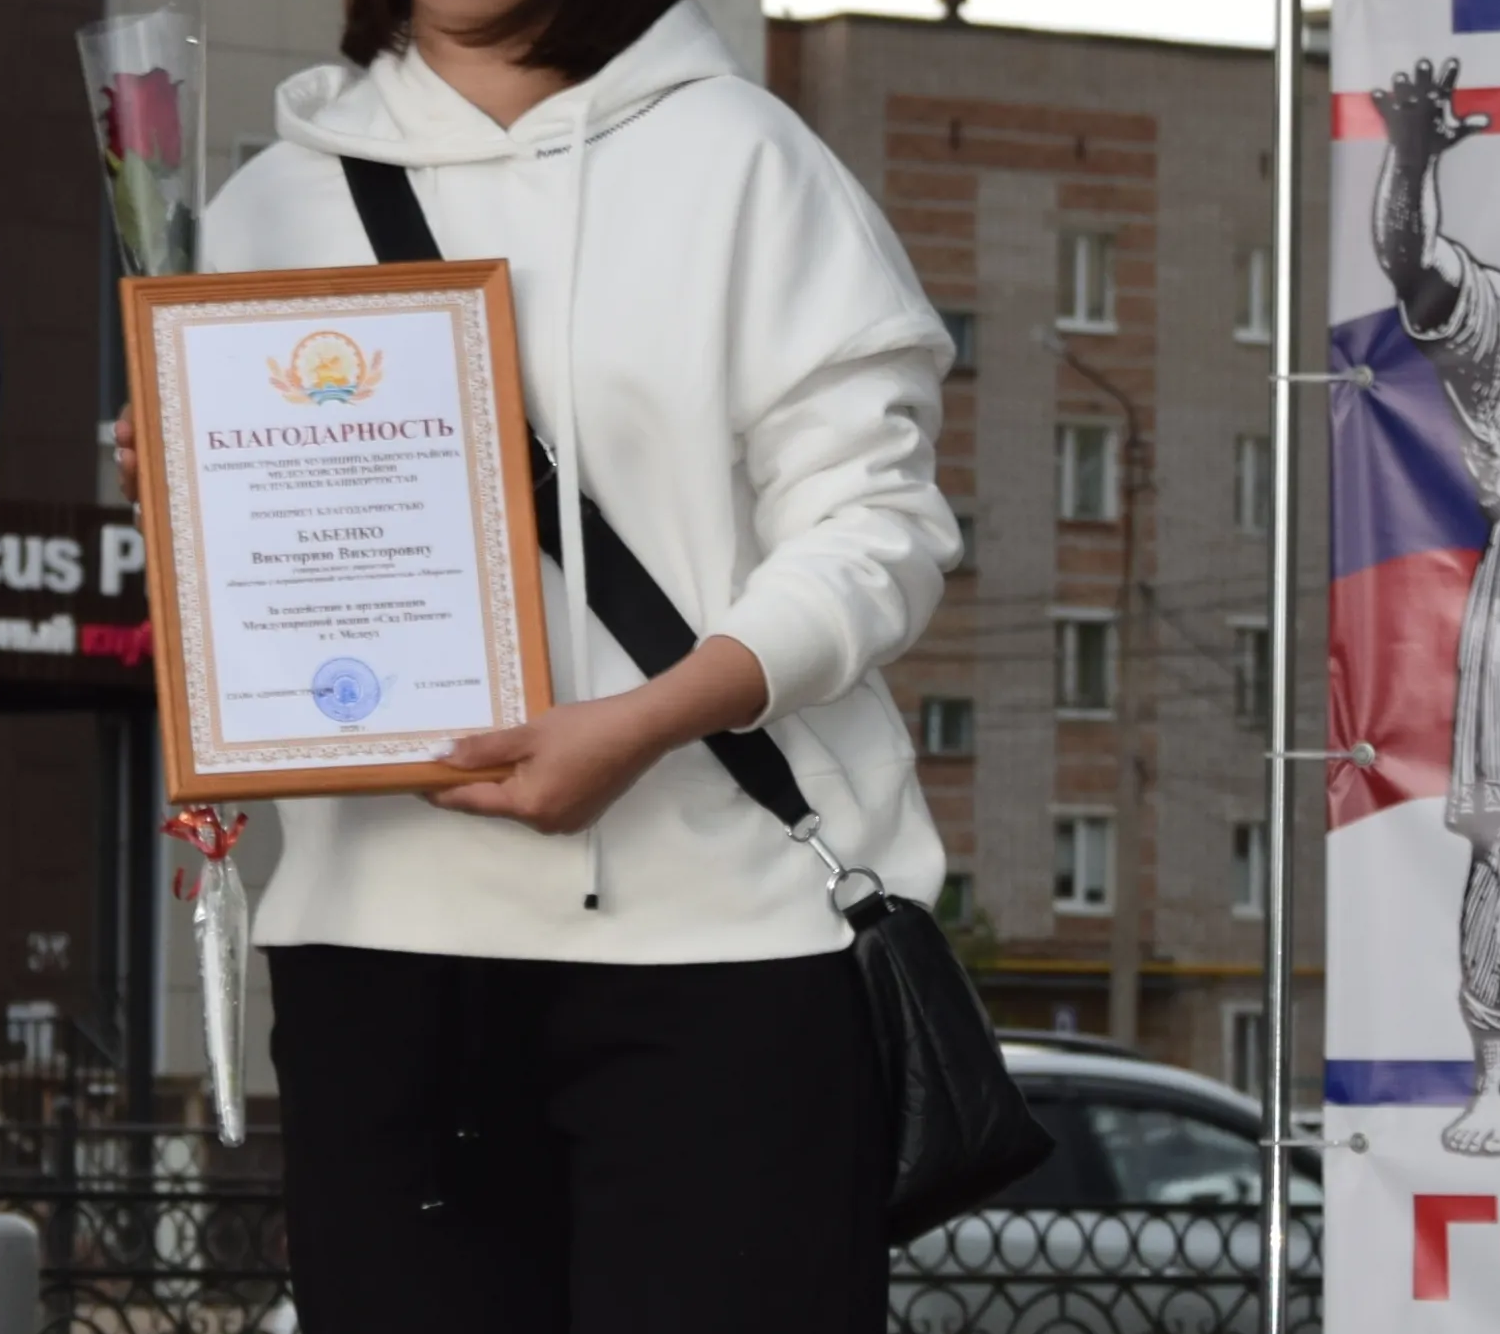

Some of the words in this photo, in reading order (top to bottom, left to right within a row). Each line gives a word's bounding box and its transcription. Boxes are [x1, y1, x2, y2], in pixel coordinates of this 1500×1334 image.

[207, 417, 454, 450] БЛАГОДАРНОСТЬ
[297, 526, 384, 543] БАБЕНКО
[251, 552, 334, 567] Викторию
[338, 544, 433, 561] Викторовну
